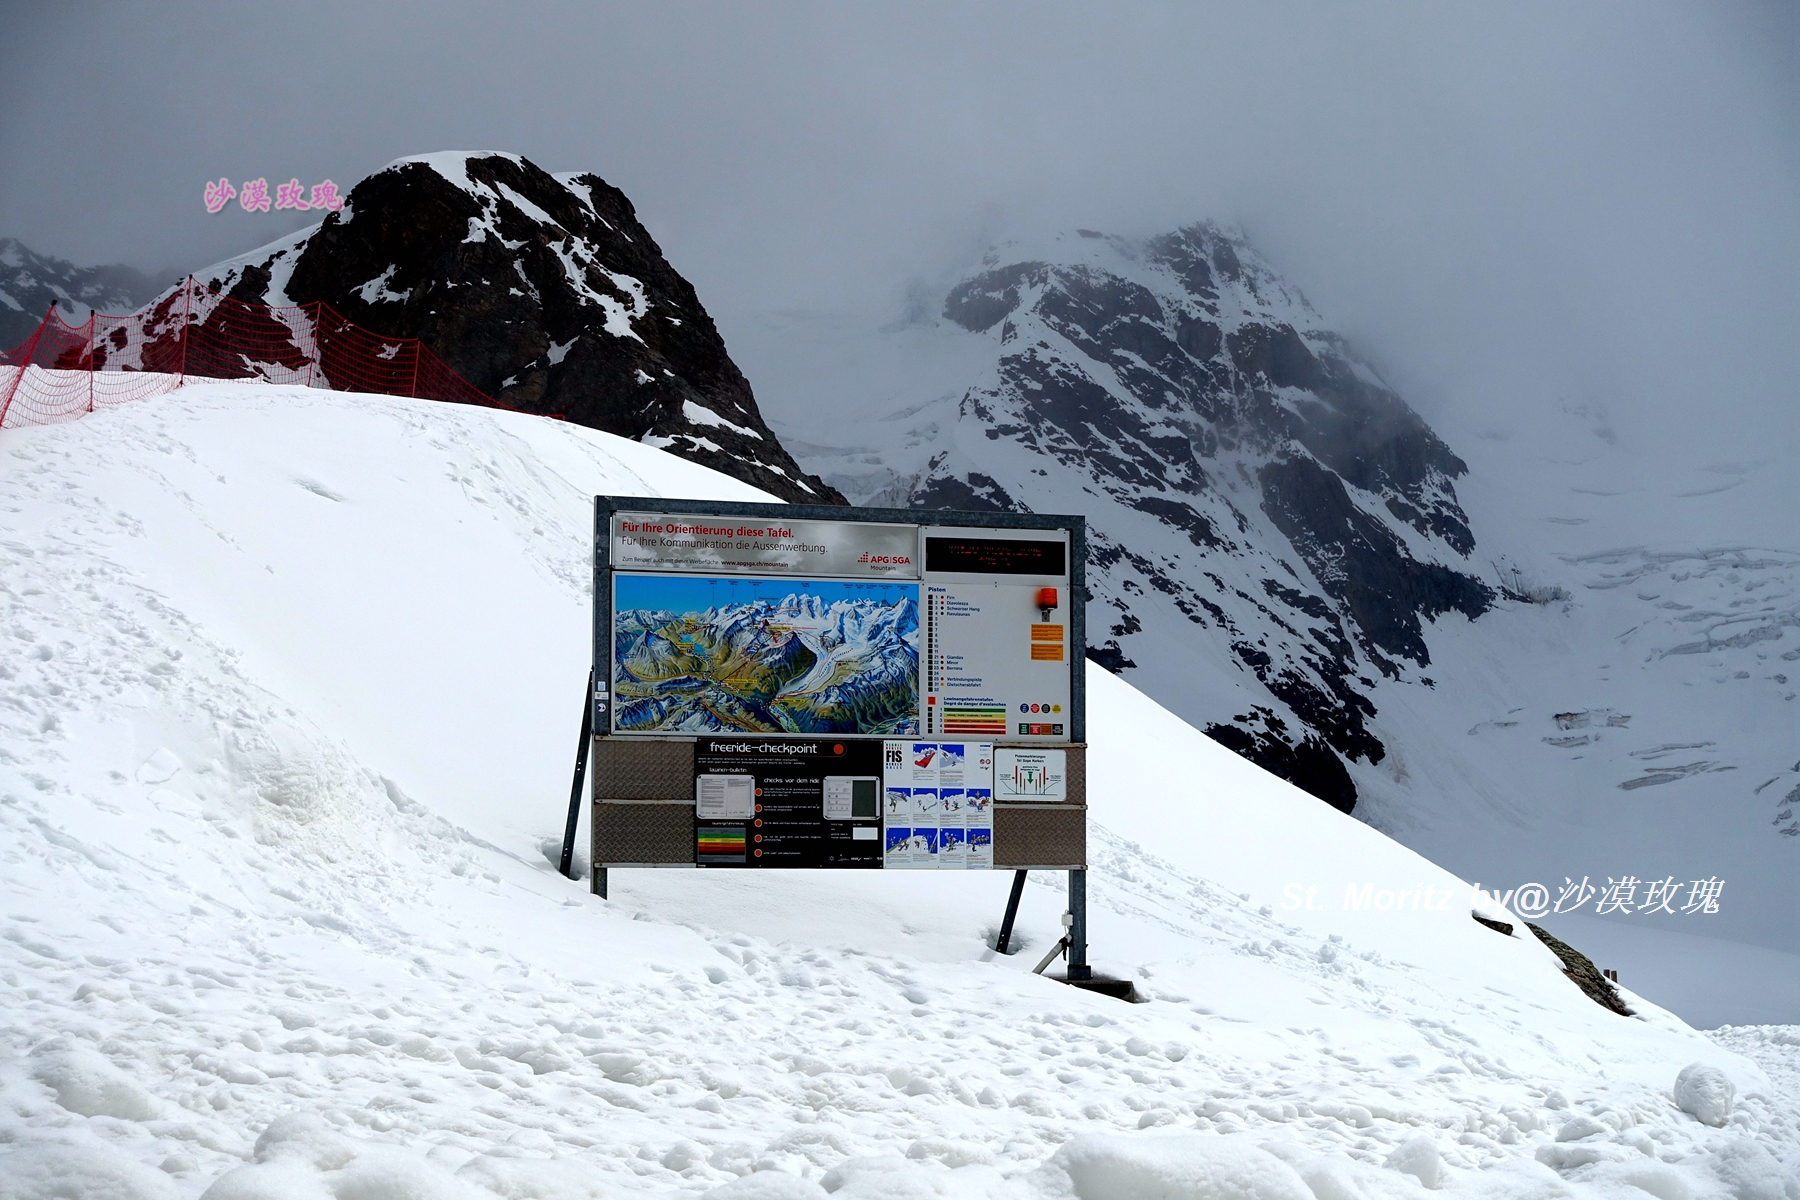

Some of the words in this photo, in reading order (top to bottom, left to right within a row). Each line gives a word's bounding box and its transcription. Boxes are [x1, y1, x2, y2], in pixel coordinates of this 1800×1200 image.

[622, 522, 639, 532] Für
[642, 523, 662, 533] Ihre
[666, 524, 733, 537] Orientierung
[736, 527, 763, 537] diese
[766, 528, 794, 538] Tafel.
[622, 536, 636, 545] Für
[639, 537, 657, 547] Ihre
[660, 538, 733, 549] Kommunikation
[736, 540, 750, 550] die
[752, 541, 828, 554] Aussenwerbung.
[634, 556, 652, 564] Beispiel
[721, 560, 789, 568] www.apgsga.ch/mountain
[709, 742, 817, 755] freeride-checkpoint
[886, 750, 902, 763] FIS
